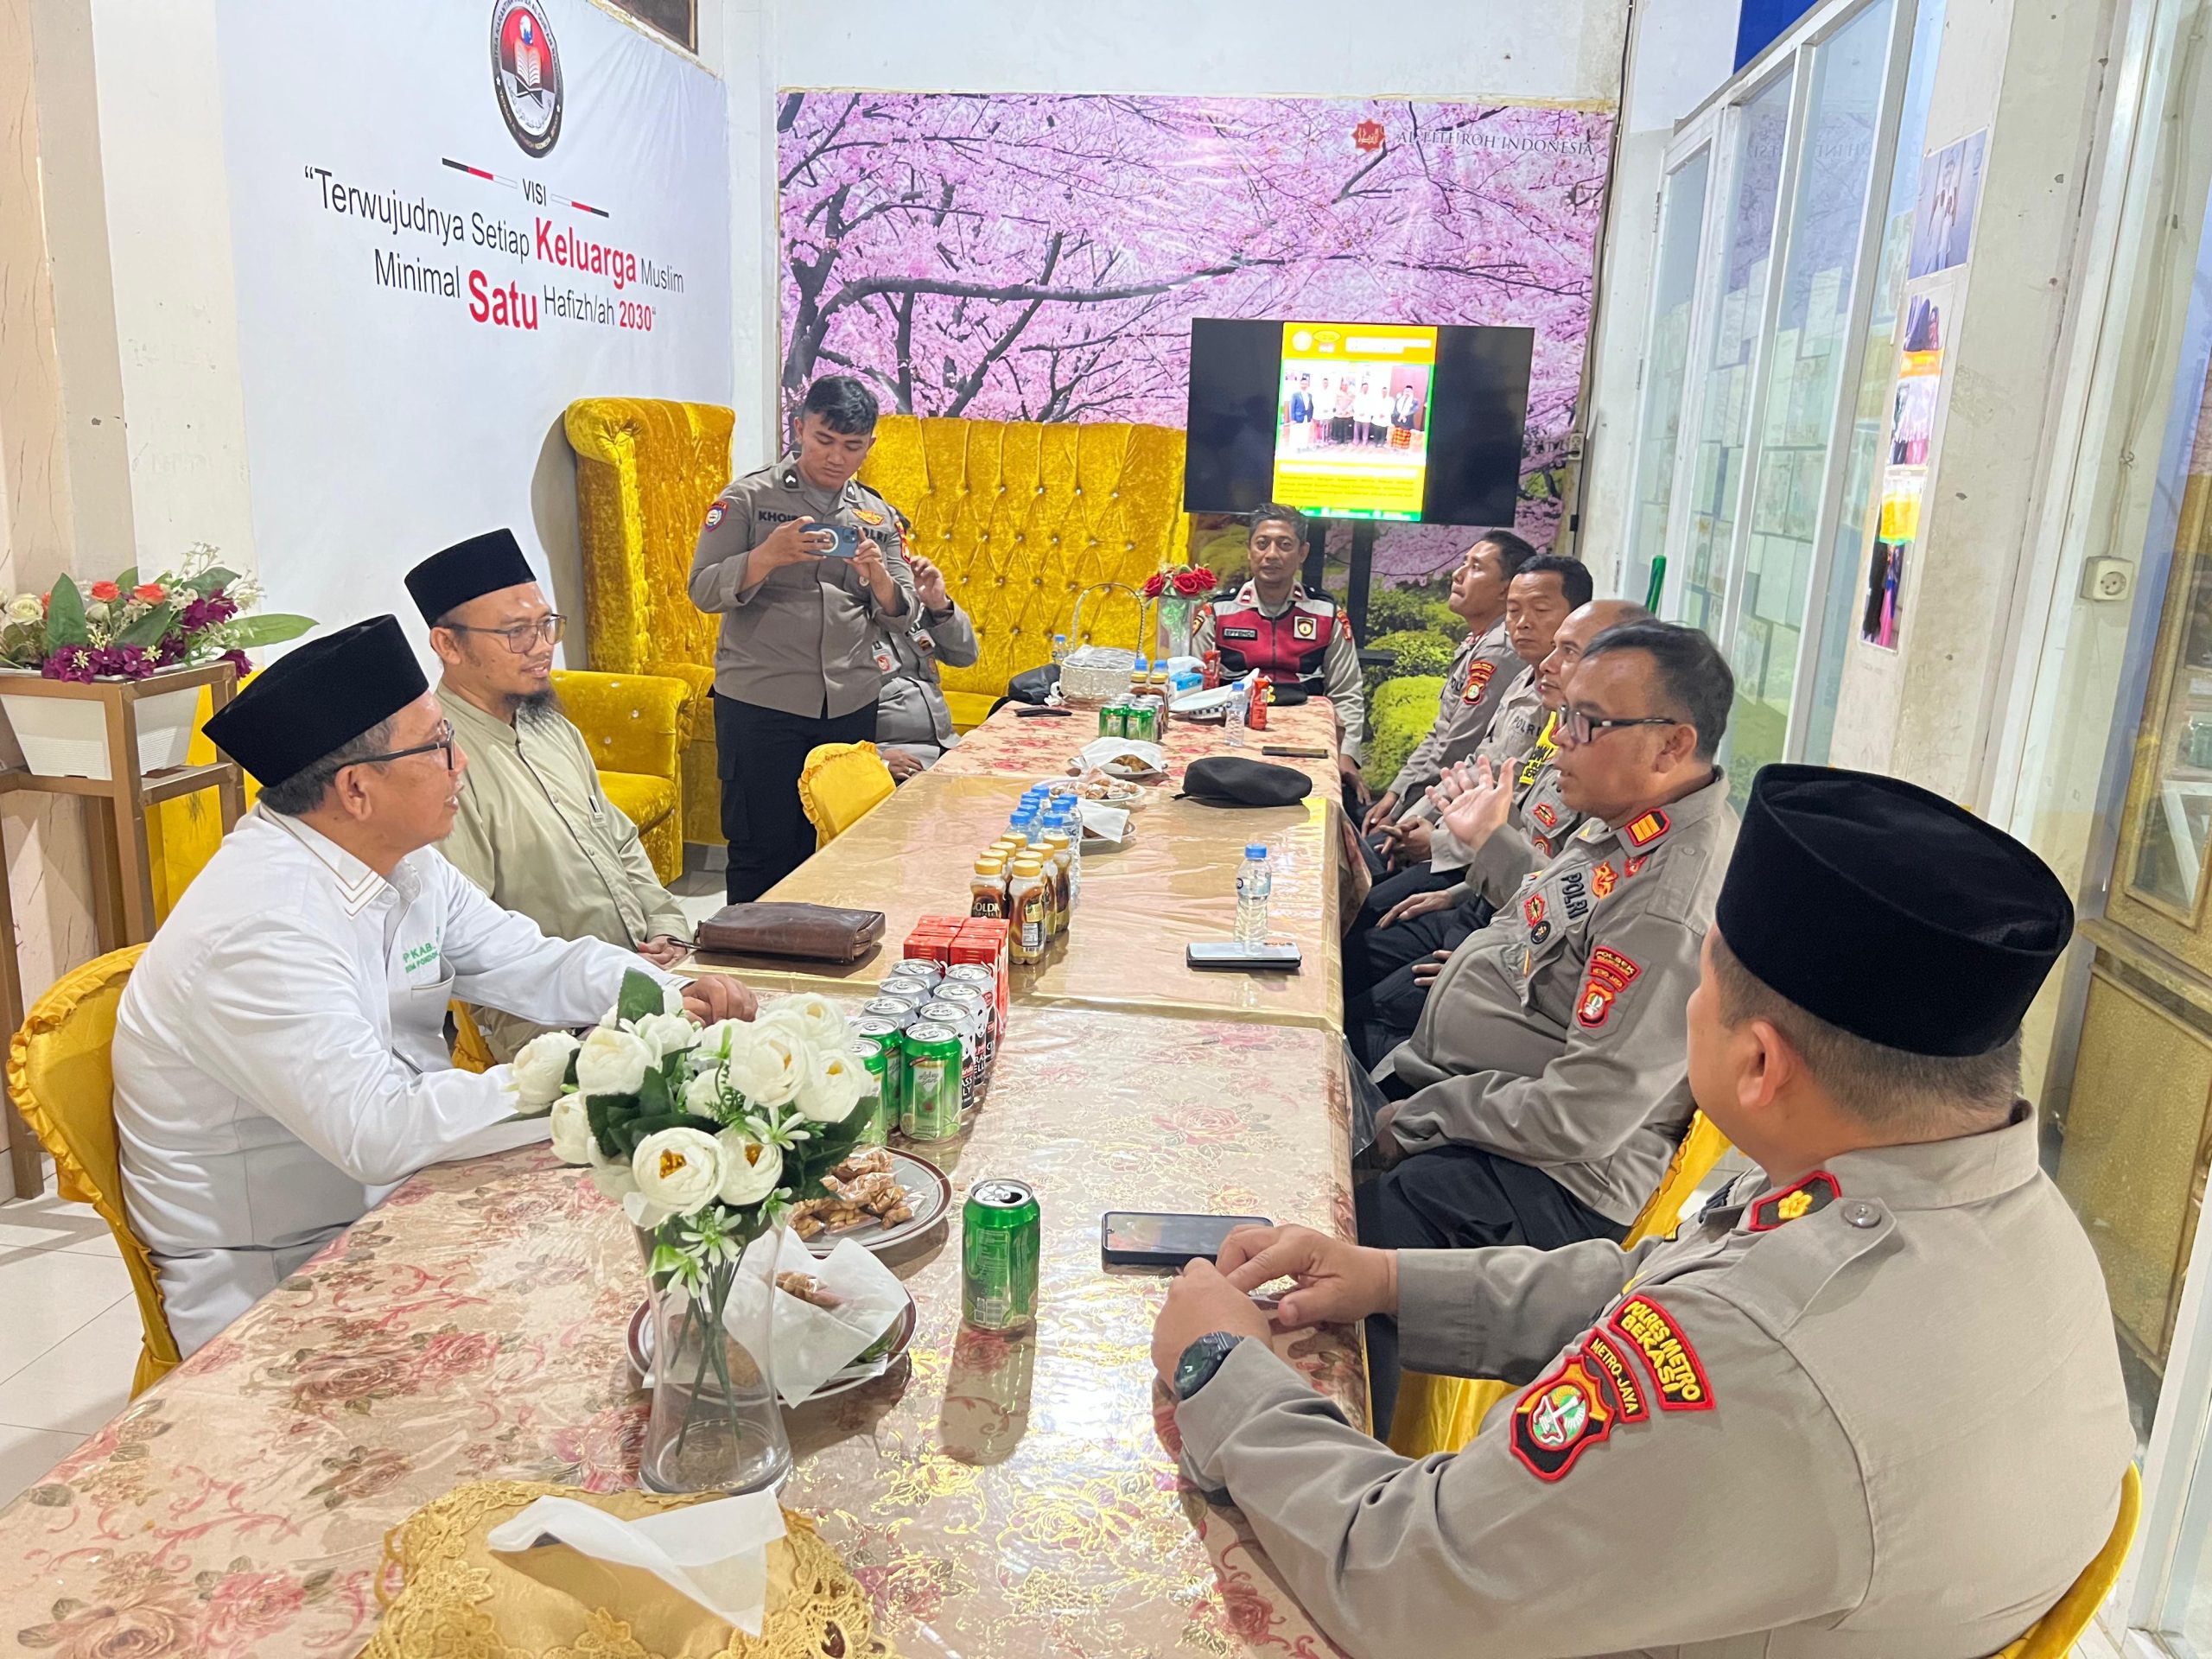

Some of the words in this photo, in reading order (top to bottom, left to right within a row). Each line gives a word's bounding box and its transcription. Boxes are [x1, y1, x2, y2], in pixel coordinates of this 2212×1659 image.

[1502, 137, 1593, 156] INDONESIA
[523, 178, 546, 207] VISI
[472, 212, 530, 264] Setiap
[536, 216, 637, 290] Keluarga
[641, 257, 684, 294] Muslim
[374, 248, 461, 299] Minimal
[467, 269, 538, 331] Satu
[543, 284, 615, 326] Hafizh/ah
[1513, 715, 1543, 737] POLRI
[974, 902, 1001, 912] OLDA
[1560, 872, 1589, 920] POLRI
[1620, 1314, 1681, 1394] BEKASI
[1624, 1300, 1670, 1342] POLRES
[1659, 1338, 1700, 1401] METRO
